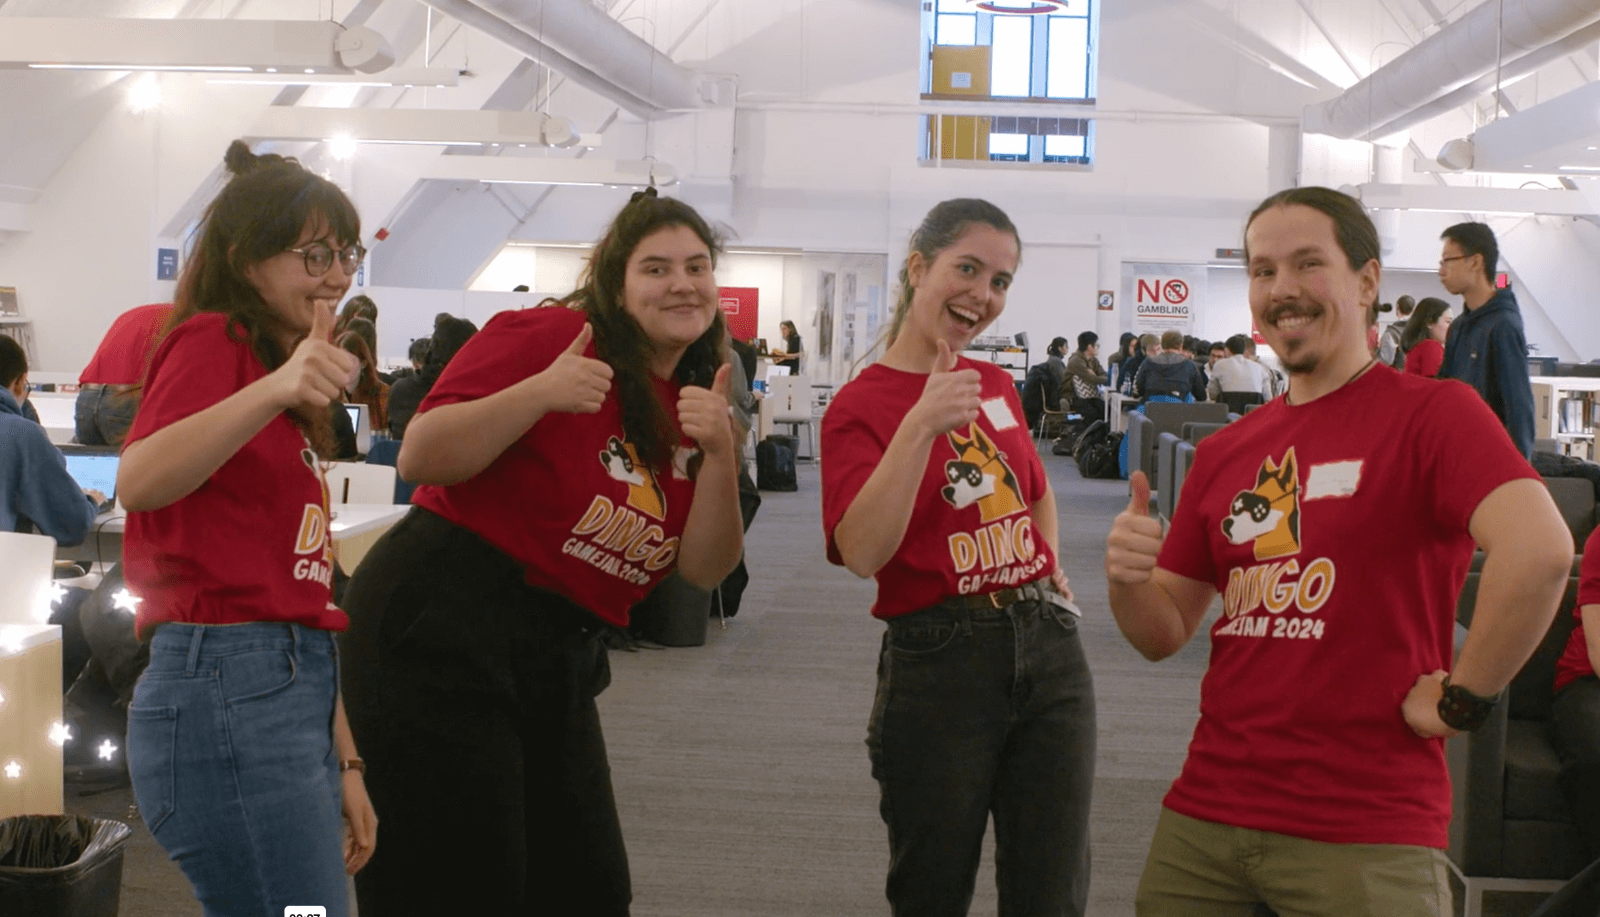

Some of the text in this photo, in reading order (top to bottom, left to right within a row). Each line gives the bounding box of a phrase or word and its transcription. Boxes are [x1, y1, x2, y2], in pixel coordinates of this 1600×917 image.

[1137, 278, 1189, 304] NO
[1137, 305, 1189, 315] GAMBLING
[571, 494, 680, 571] DINGO
[948, 516, 1035, 573] DING
[1272, 617, 1326, 640] 2024
